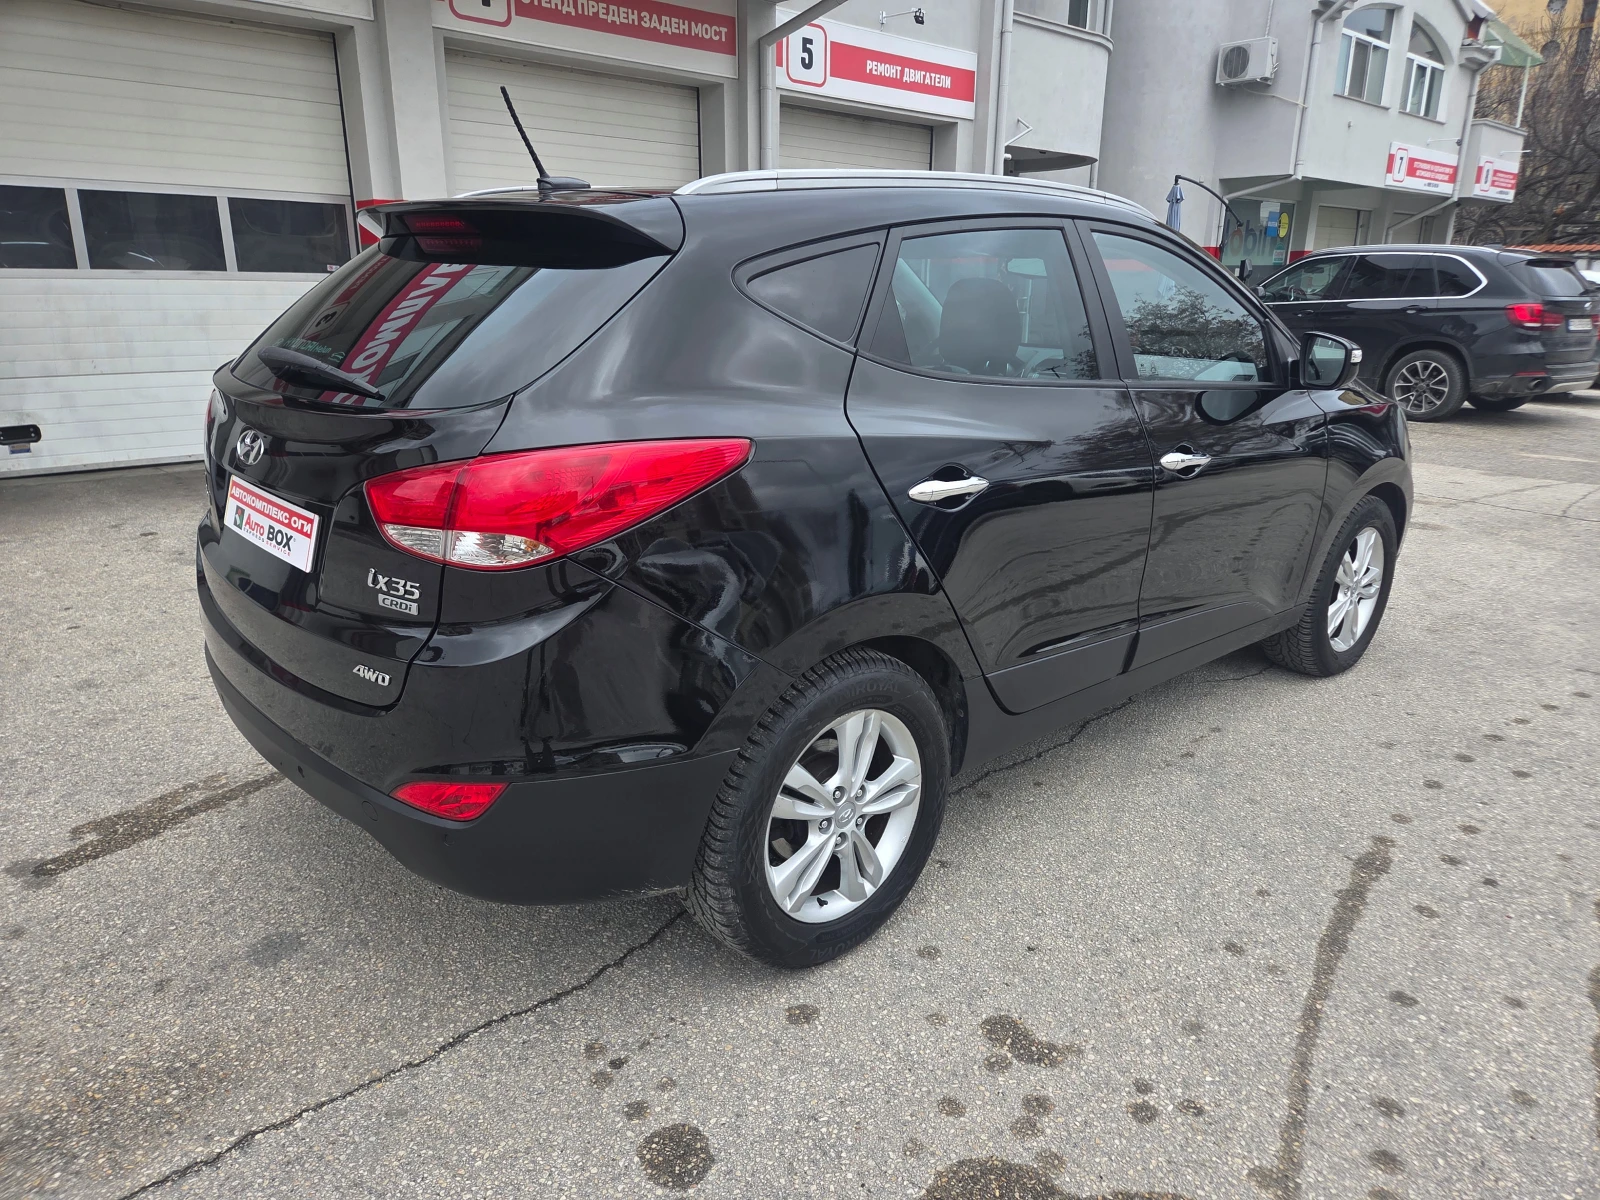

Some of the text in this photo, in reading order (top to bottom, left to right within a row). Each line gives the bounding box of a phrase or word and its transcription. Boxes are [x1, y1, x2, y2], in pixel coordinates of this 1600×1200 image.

[577, 0, 638, 25] ПРЕДЕН
[640, 11, 689, 35] ЗАДЕН
[691, 22, 728, 42] МОСТ
[800, 36, 814, 70] 5
[866, 59, 951, 89] РЕМОНТ ДВИГАТЕЛИ
[1398, 156, 1404, 175] 7
[230, 485, 312, 534] АВТОКОМПЛЕКС ОГИ
[266, 524, 293, 552] BOX
[266, 540, 291, 557] SERVICE
[367, 567, 420, 600] ix35
[381, 597, 413, 612] CRDi
[353, 664, 391, 686] 4WD
